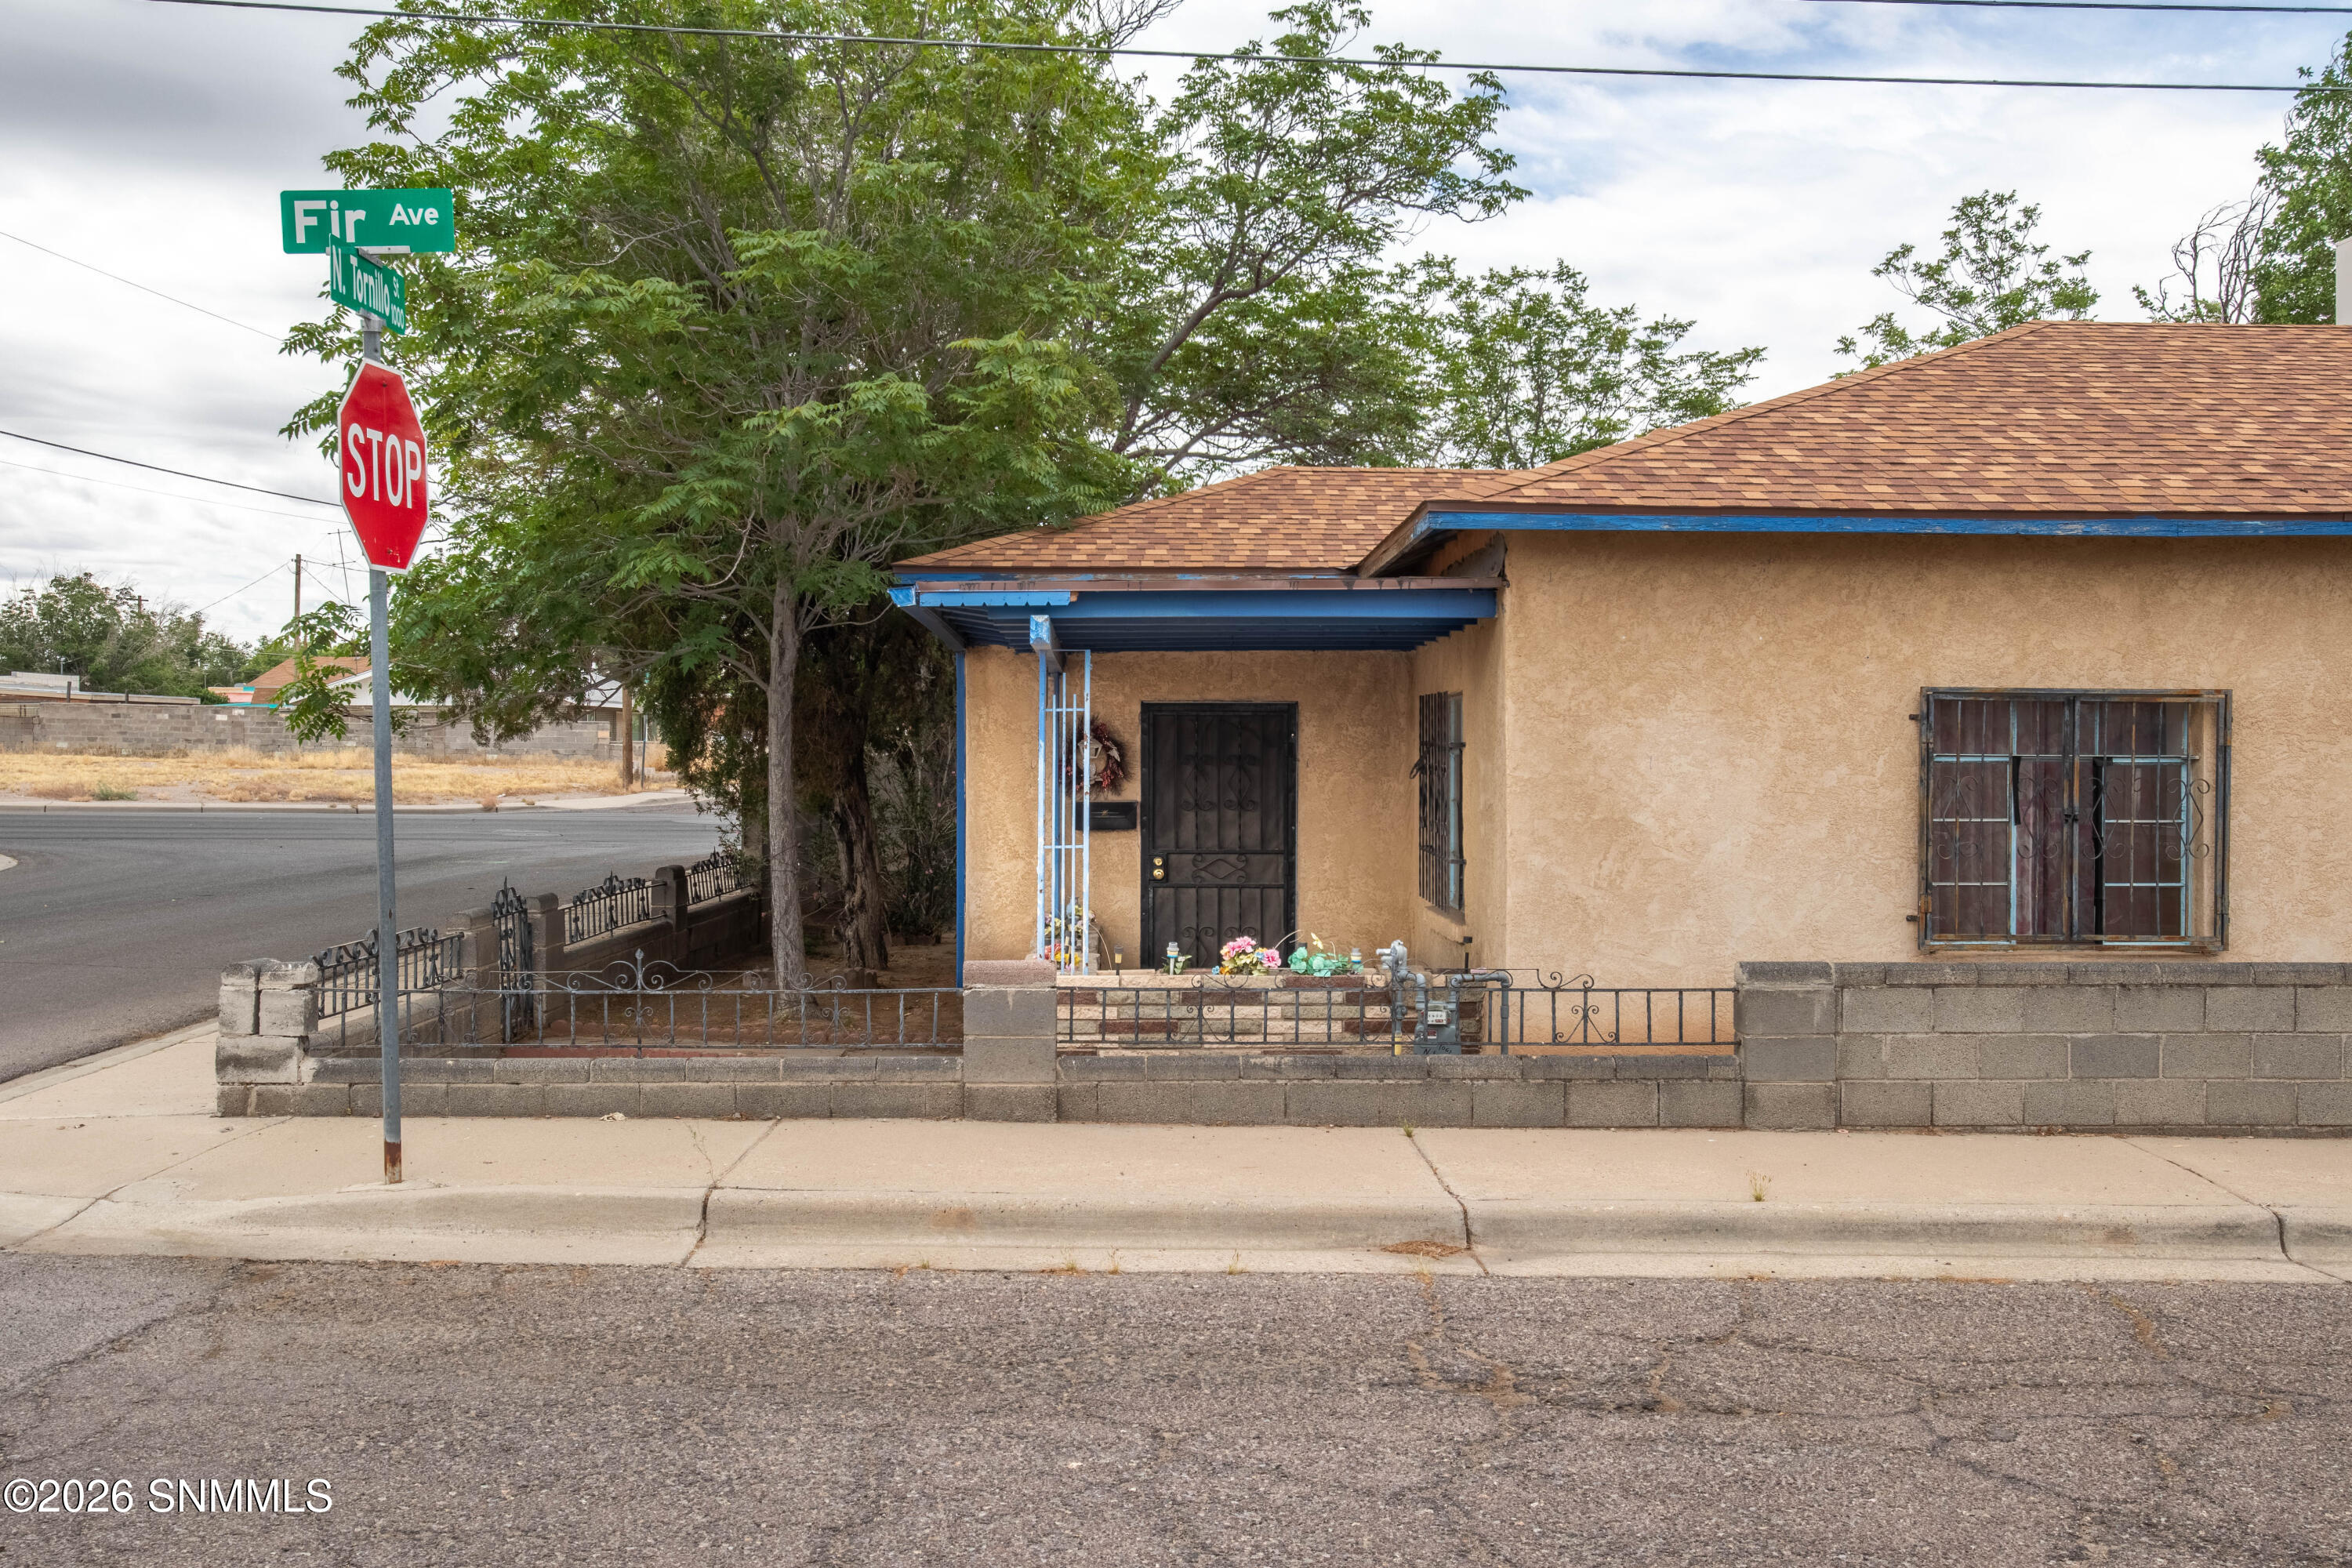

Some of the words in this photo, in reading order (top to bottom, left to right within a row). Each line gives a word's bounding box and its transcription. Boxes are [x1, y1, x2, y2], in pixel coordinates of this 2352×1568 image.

[294, 200, 366, 243] Fir
[389, 203, 439, 225] Ave
[350, 255, 390, 317] Tornillo
[393, 276, 400, 299] St
[391, 303, 405, 329] 1000
[347, 423, 422, 509] STOP
